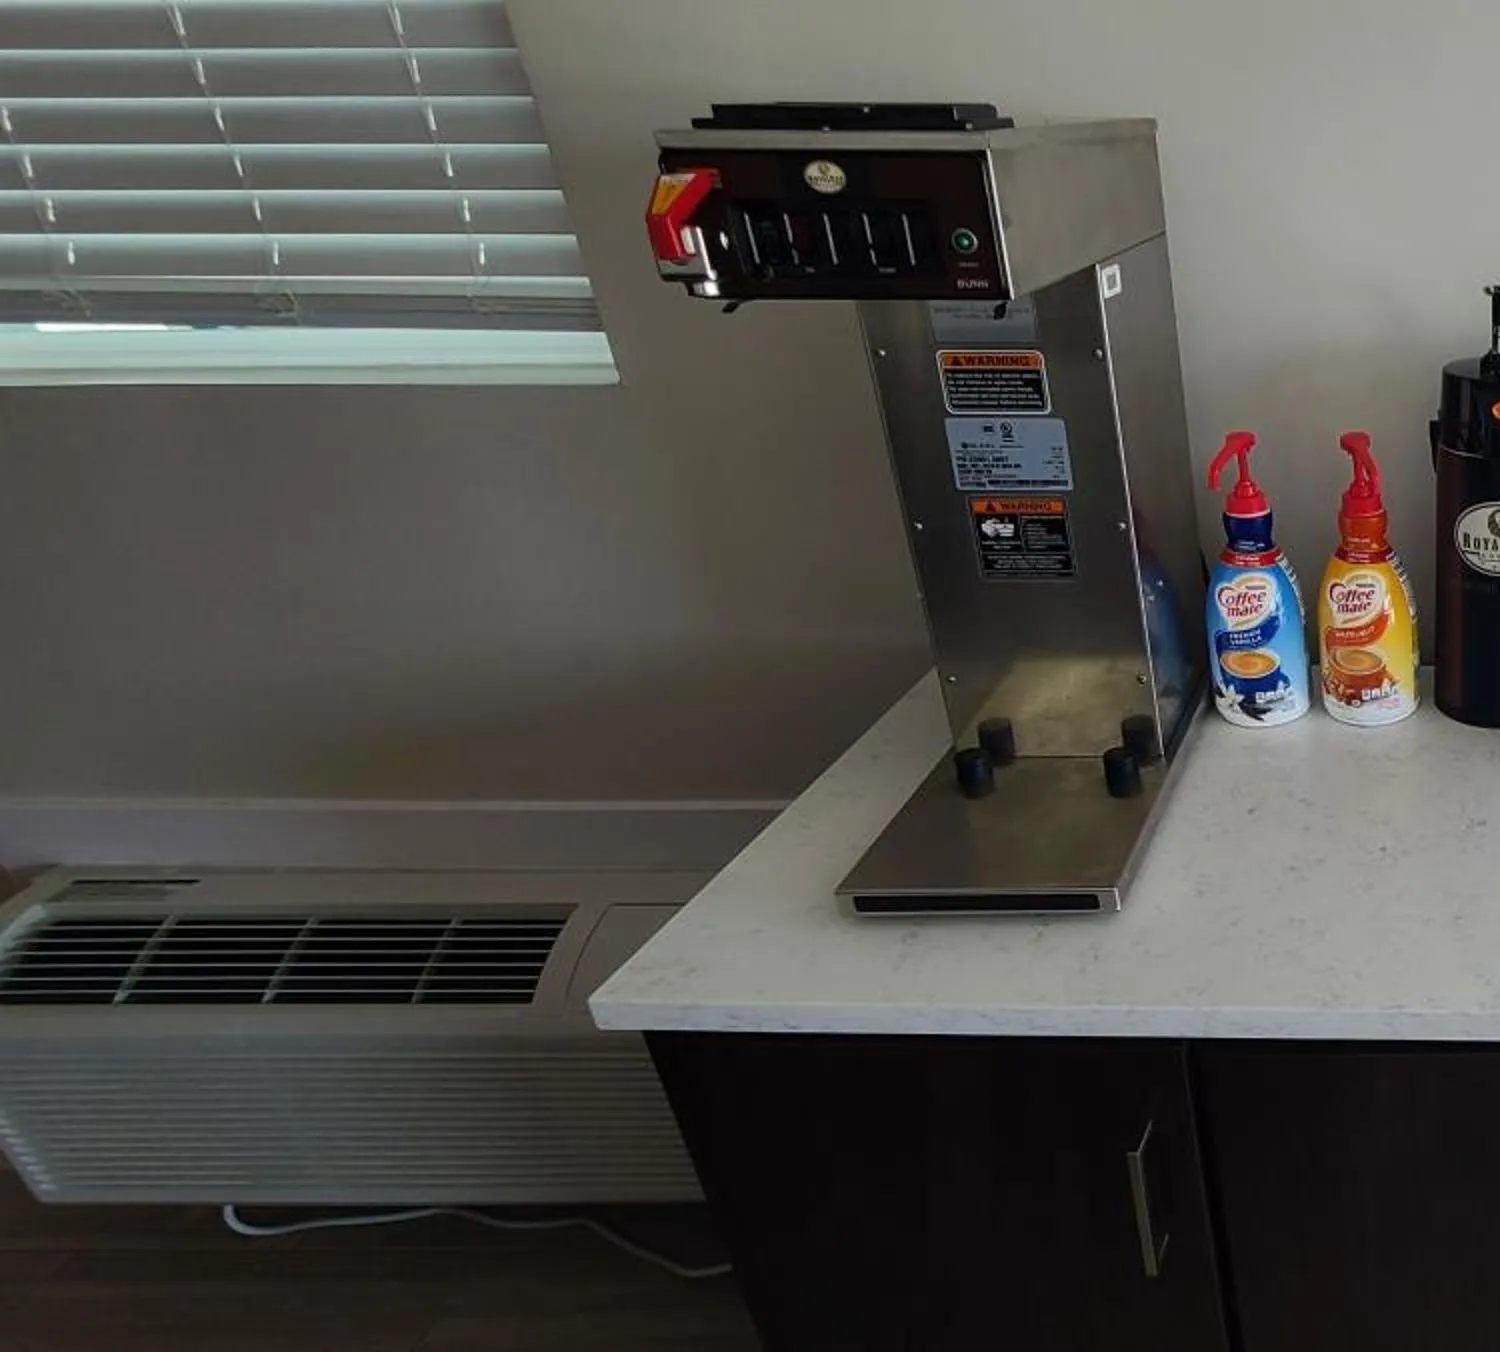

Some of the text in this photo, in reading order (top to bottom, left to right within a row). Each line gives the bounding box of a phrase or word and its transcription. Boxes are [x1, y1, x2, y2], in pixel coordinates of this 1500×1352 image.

[963, 355, 1030, 367] WARNING
[1217, 586, 1267, 608] Coffee
[1329, 582, 1376, 604] Coffee
[1227, 603, 1264, 617] mate
[1337, 601, 1373, 613] mate
